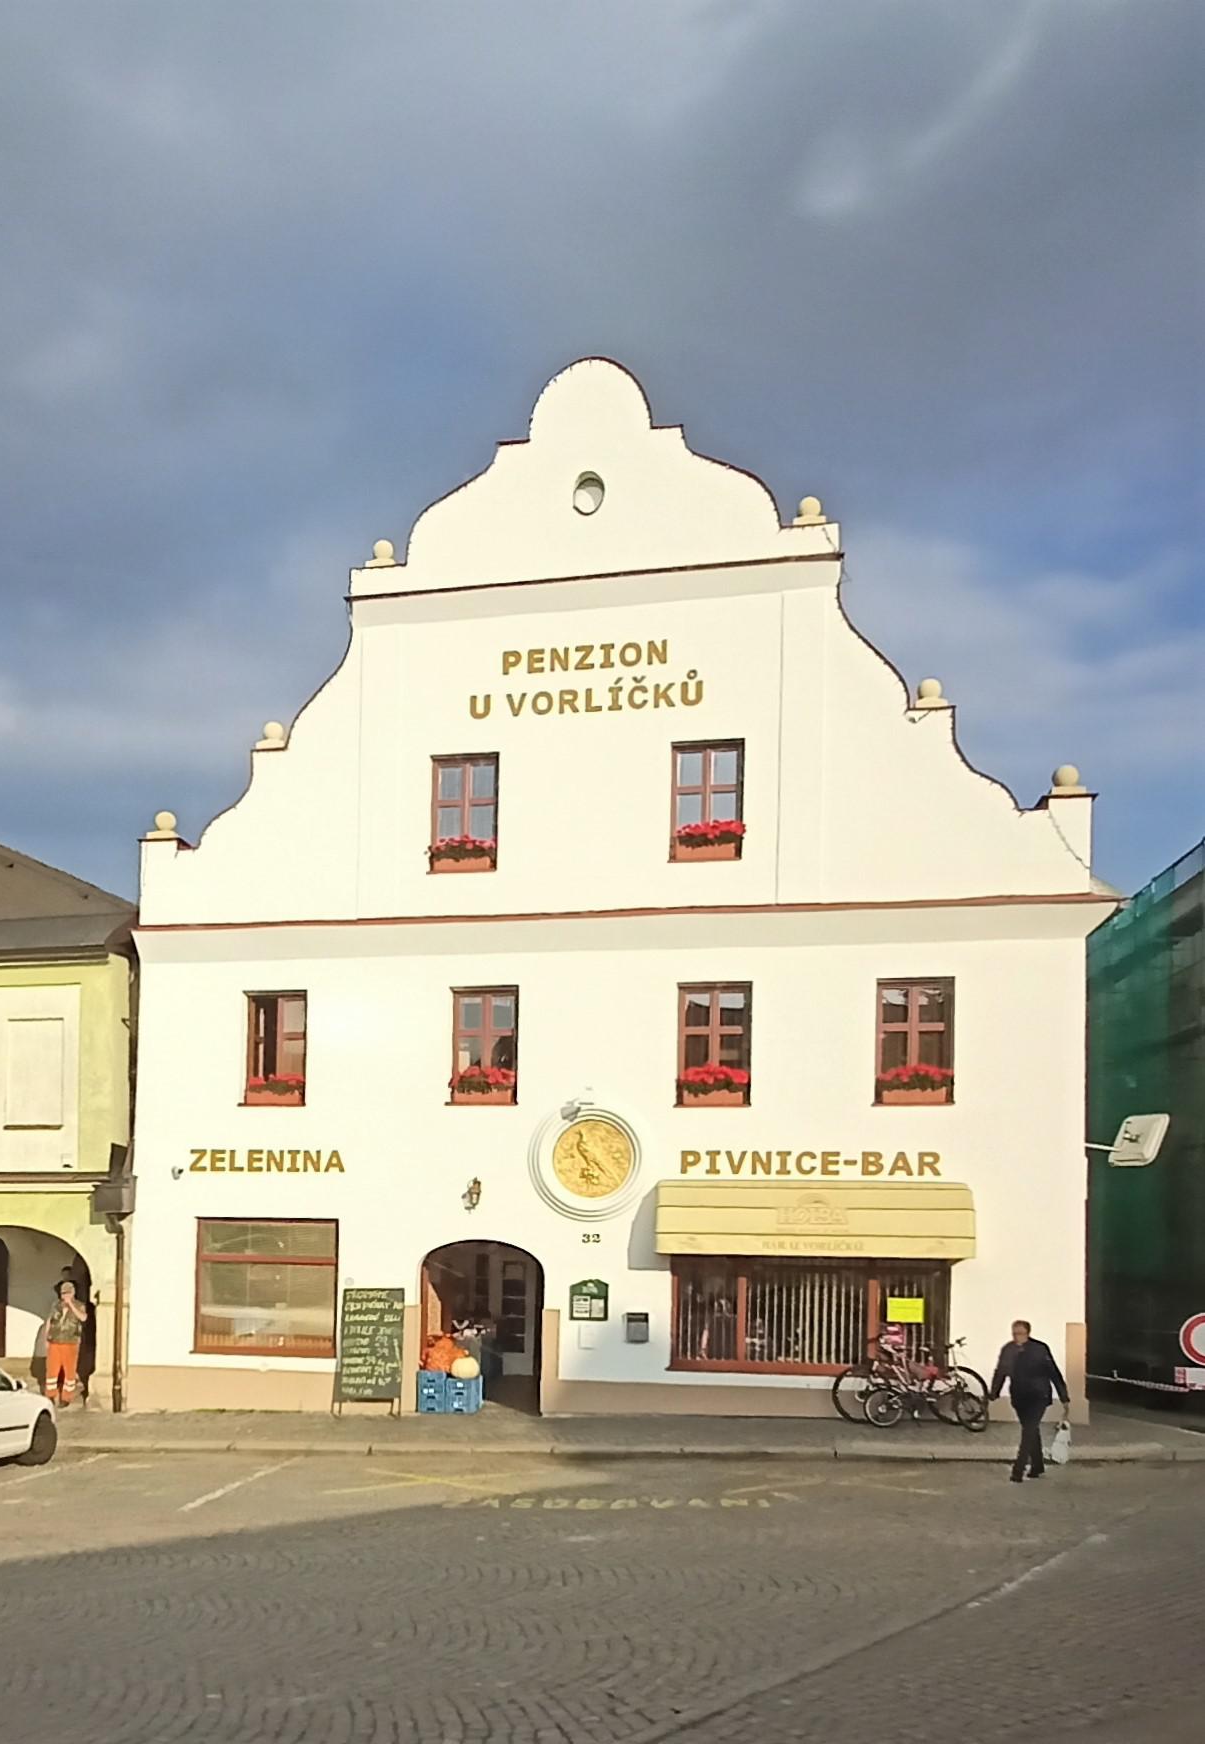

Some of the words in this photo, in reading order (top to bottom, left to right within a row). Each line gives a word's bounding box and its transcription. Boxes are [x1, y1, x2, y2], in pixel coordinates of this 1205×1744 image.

[502, 639, 668, 675] PENZION
[469, 694, 492, 720] U
[506, 669, 704, 717] VORLÍČKŮ
[189, 1148, 346, 1173] ZELENINA
[680, 1150, 942, 1177] PIVNICE-BAR
[581, 1233, 602, 1244] 32
